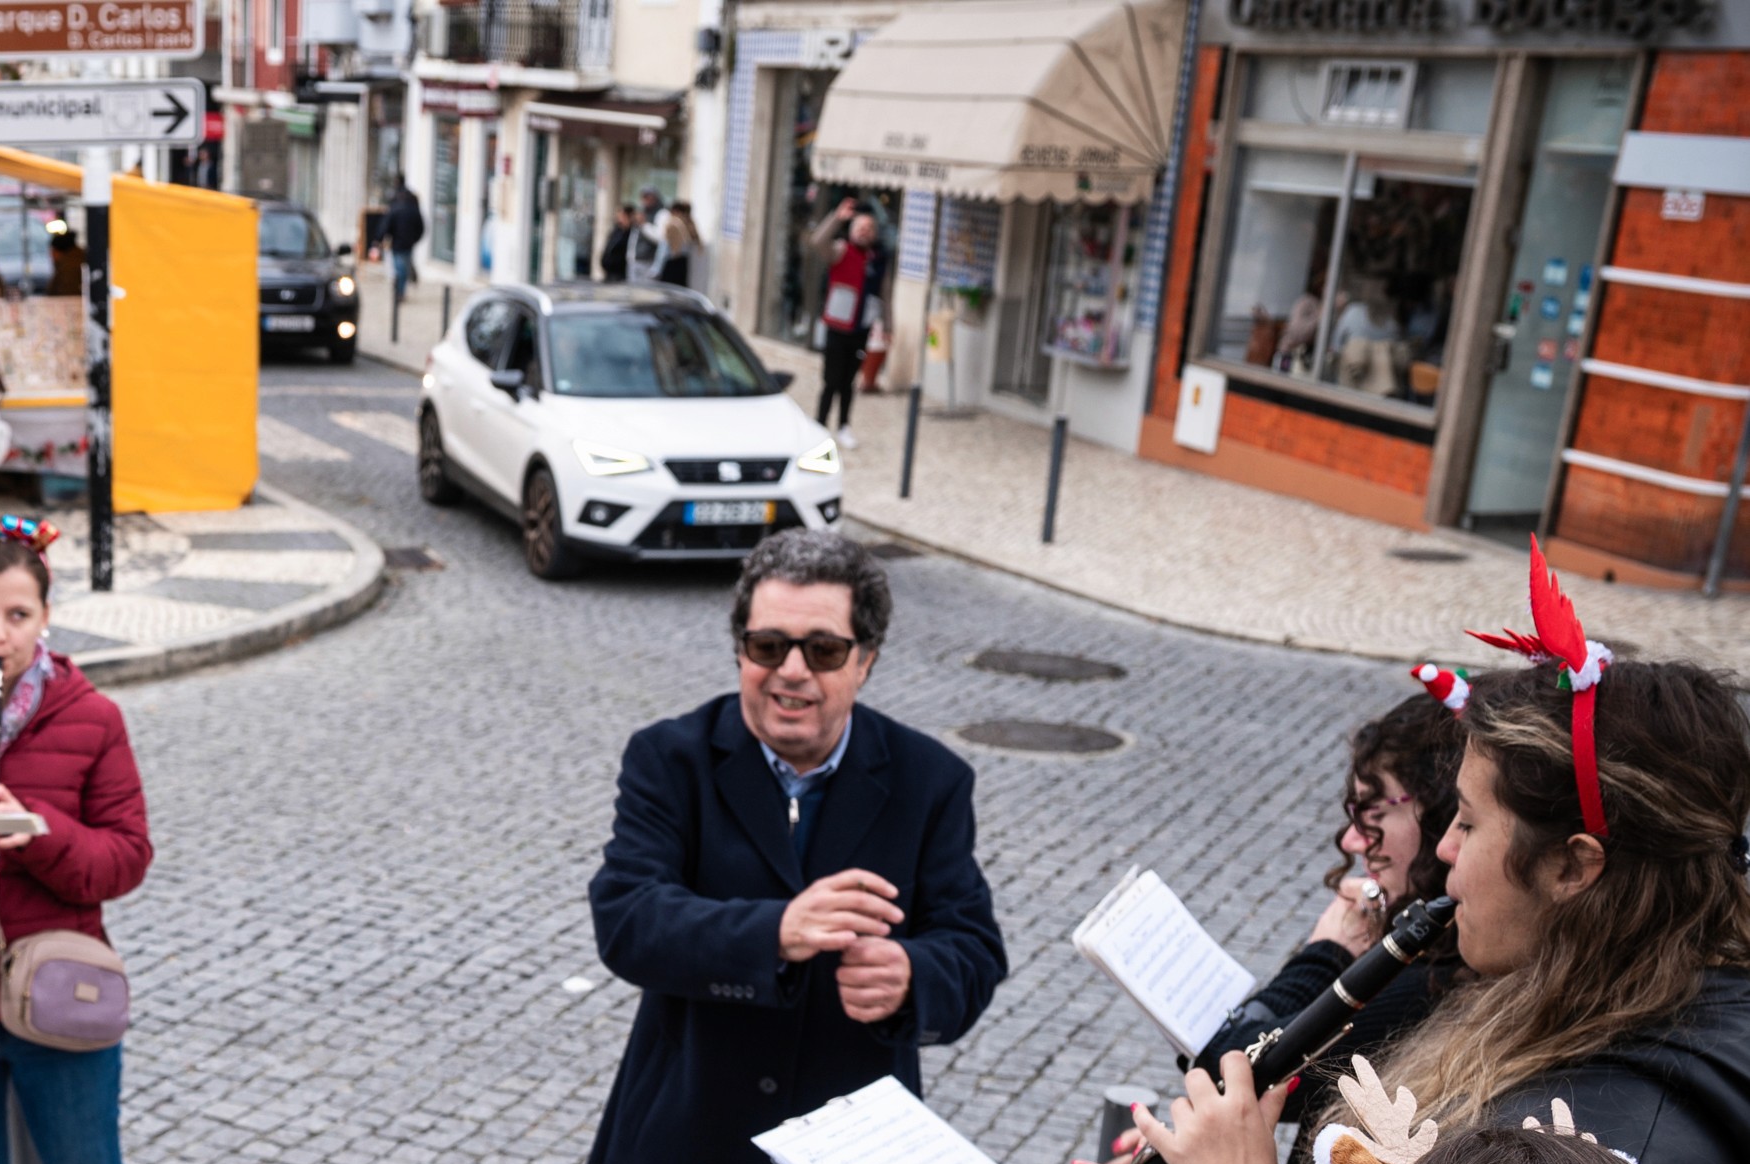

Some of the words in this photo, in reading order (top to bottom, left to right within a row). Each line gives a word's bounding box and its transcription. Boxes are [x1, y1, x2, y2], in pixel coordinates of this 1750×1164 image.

[67, 3, 94, 31] D.
[98, 2, 181, 31] Carlos
[88, 30, 144, 49] Carlos
[155, 30, 193, 49] park
